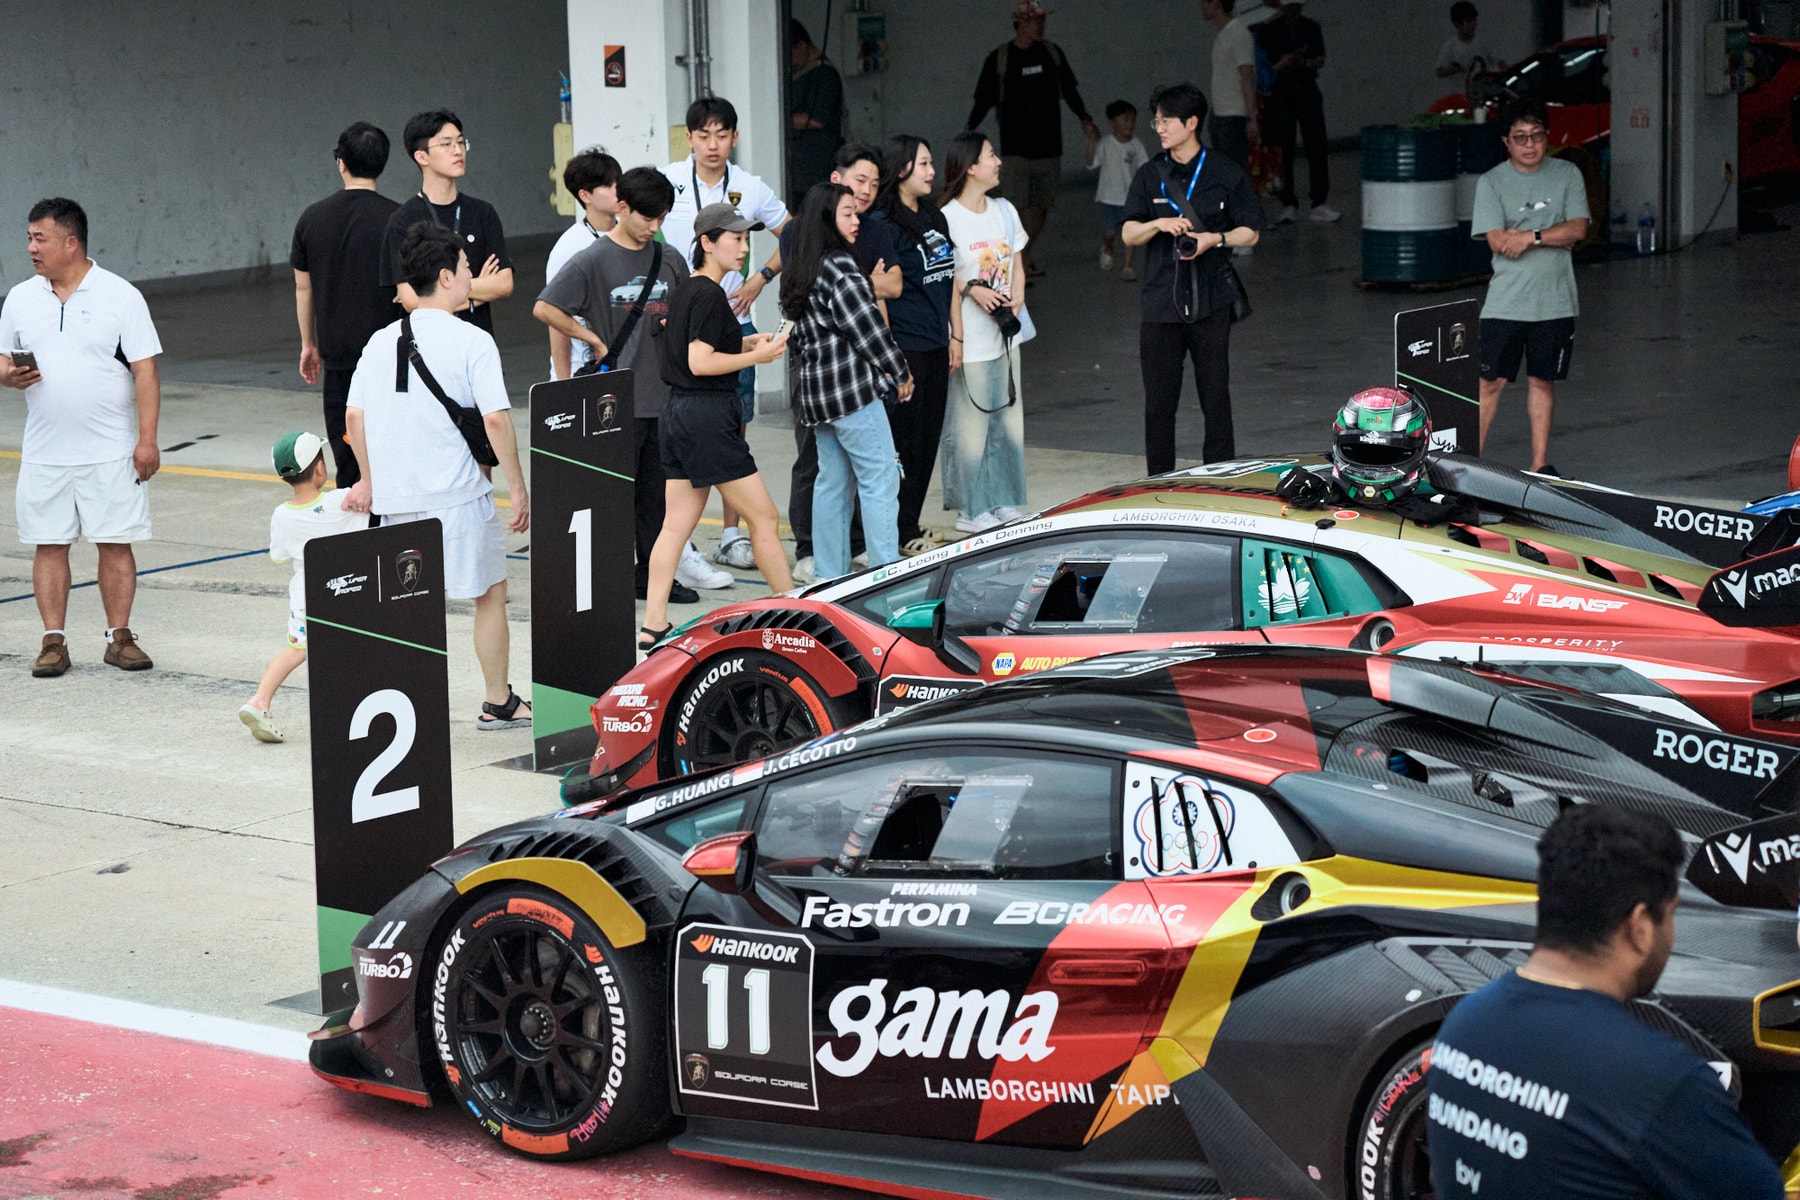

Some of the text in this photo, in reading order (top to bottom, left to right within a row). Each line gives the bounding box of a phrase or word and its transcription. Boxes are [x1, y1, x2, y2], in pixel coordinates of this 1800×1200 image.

[973, 520, 1053, 547] A. Denning
[1112, 511, 1257, 528] LAMBORGHINI OSAKA
[1653, 504, 1755, 542] ROGER
[568, 508, 592, 613] 1
[887, 549, 949, 576] C. Leong
[773, 633, 816, 649] Arcadia
[994, 656, 1013, 669] NAPA
[1019, 656, 1053, 671] AUTO
[348, 688, 420, 824] 2
[763, 736, 857, 776] J.CECOTTO
[1653, 728, 1779, 780] ROGER
[655, 773, 731, 811] G.HUANG
[890, 882, 978, 897] PERTAMINA
[800, 896, 971, 928] Fastron
[702, 963, 771, 1055] 11
[815, 978, 1060, 1078] gama
[770, 1077, 808, 1090] CORSE
[924, 1076, 1180, 1106] LAMBORGHINI TAIP
[1455, 1157, 1482, 1195] by
